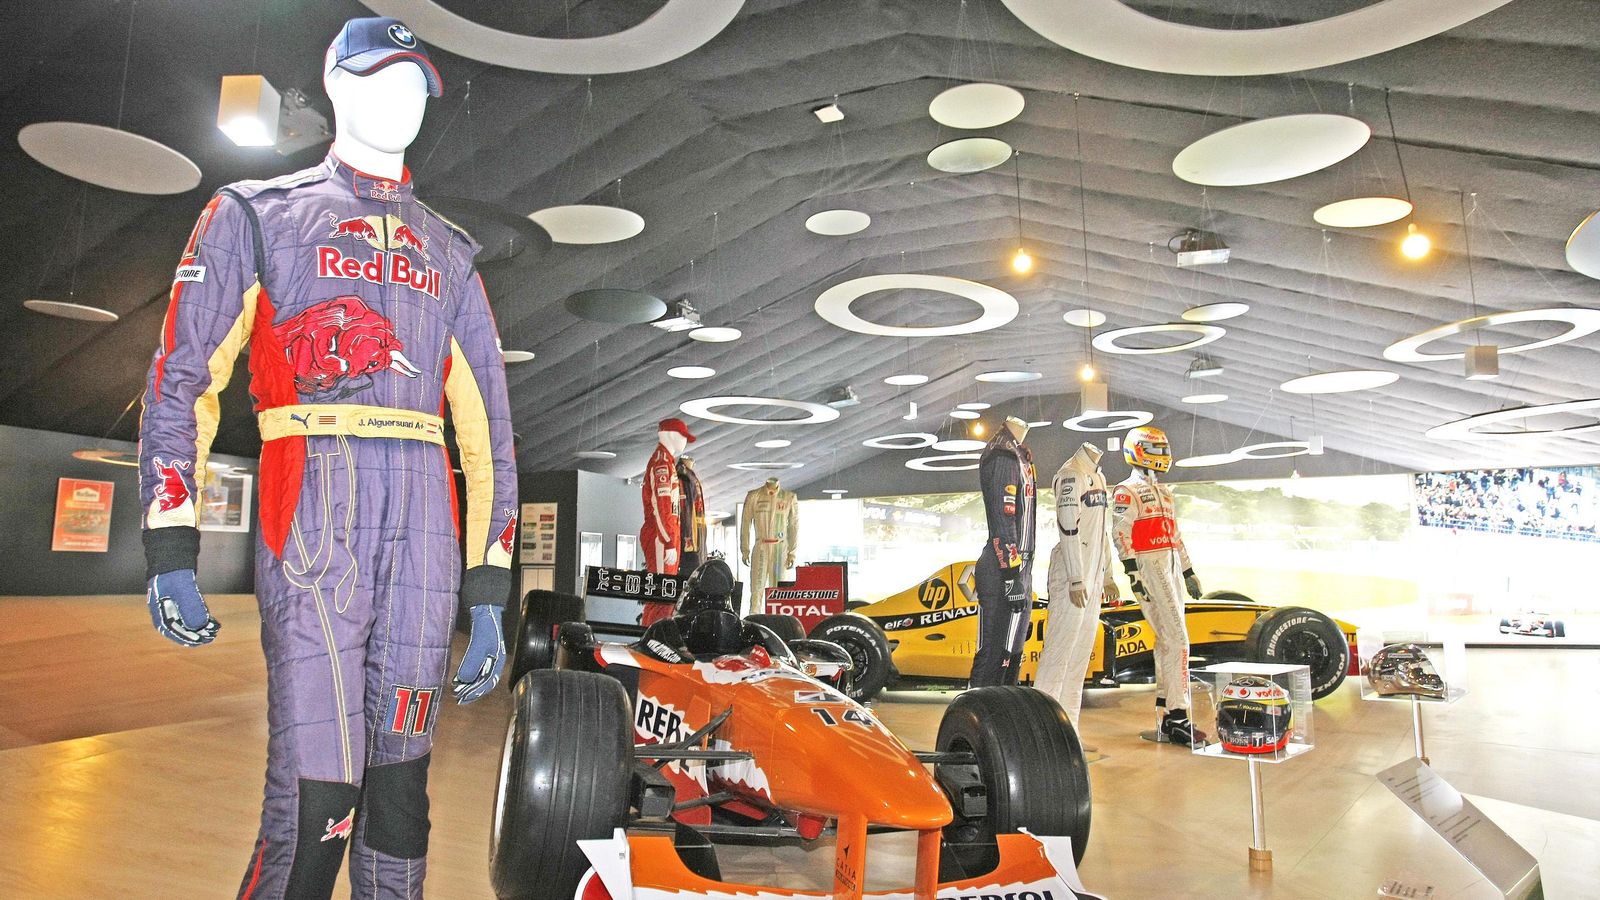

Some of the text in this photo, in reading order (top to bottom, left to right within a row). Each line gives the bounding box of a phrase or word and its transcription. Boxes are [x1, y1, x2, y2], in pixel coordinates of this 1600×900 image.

[370, 190, 389, 200] Red
[317, 246, 441, 301] Red Bull
[367, 418, 413, 428] Alguersuari
[767, 589, 839, 600] BRIDGESTONE
[922, 581, 947, 610] hp
[766, 603, 834, 616] TOTAL
[920, 604, 978, 625] RENAU
[826, 625, 876, 647] POTENZA
[1266, 616, 1308, 657] BRIDGESTONE
[1117, 639, 1147, 656] ADA
[391, 687, 433, 734] 11
[811, 707, 875, 727] 14
